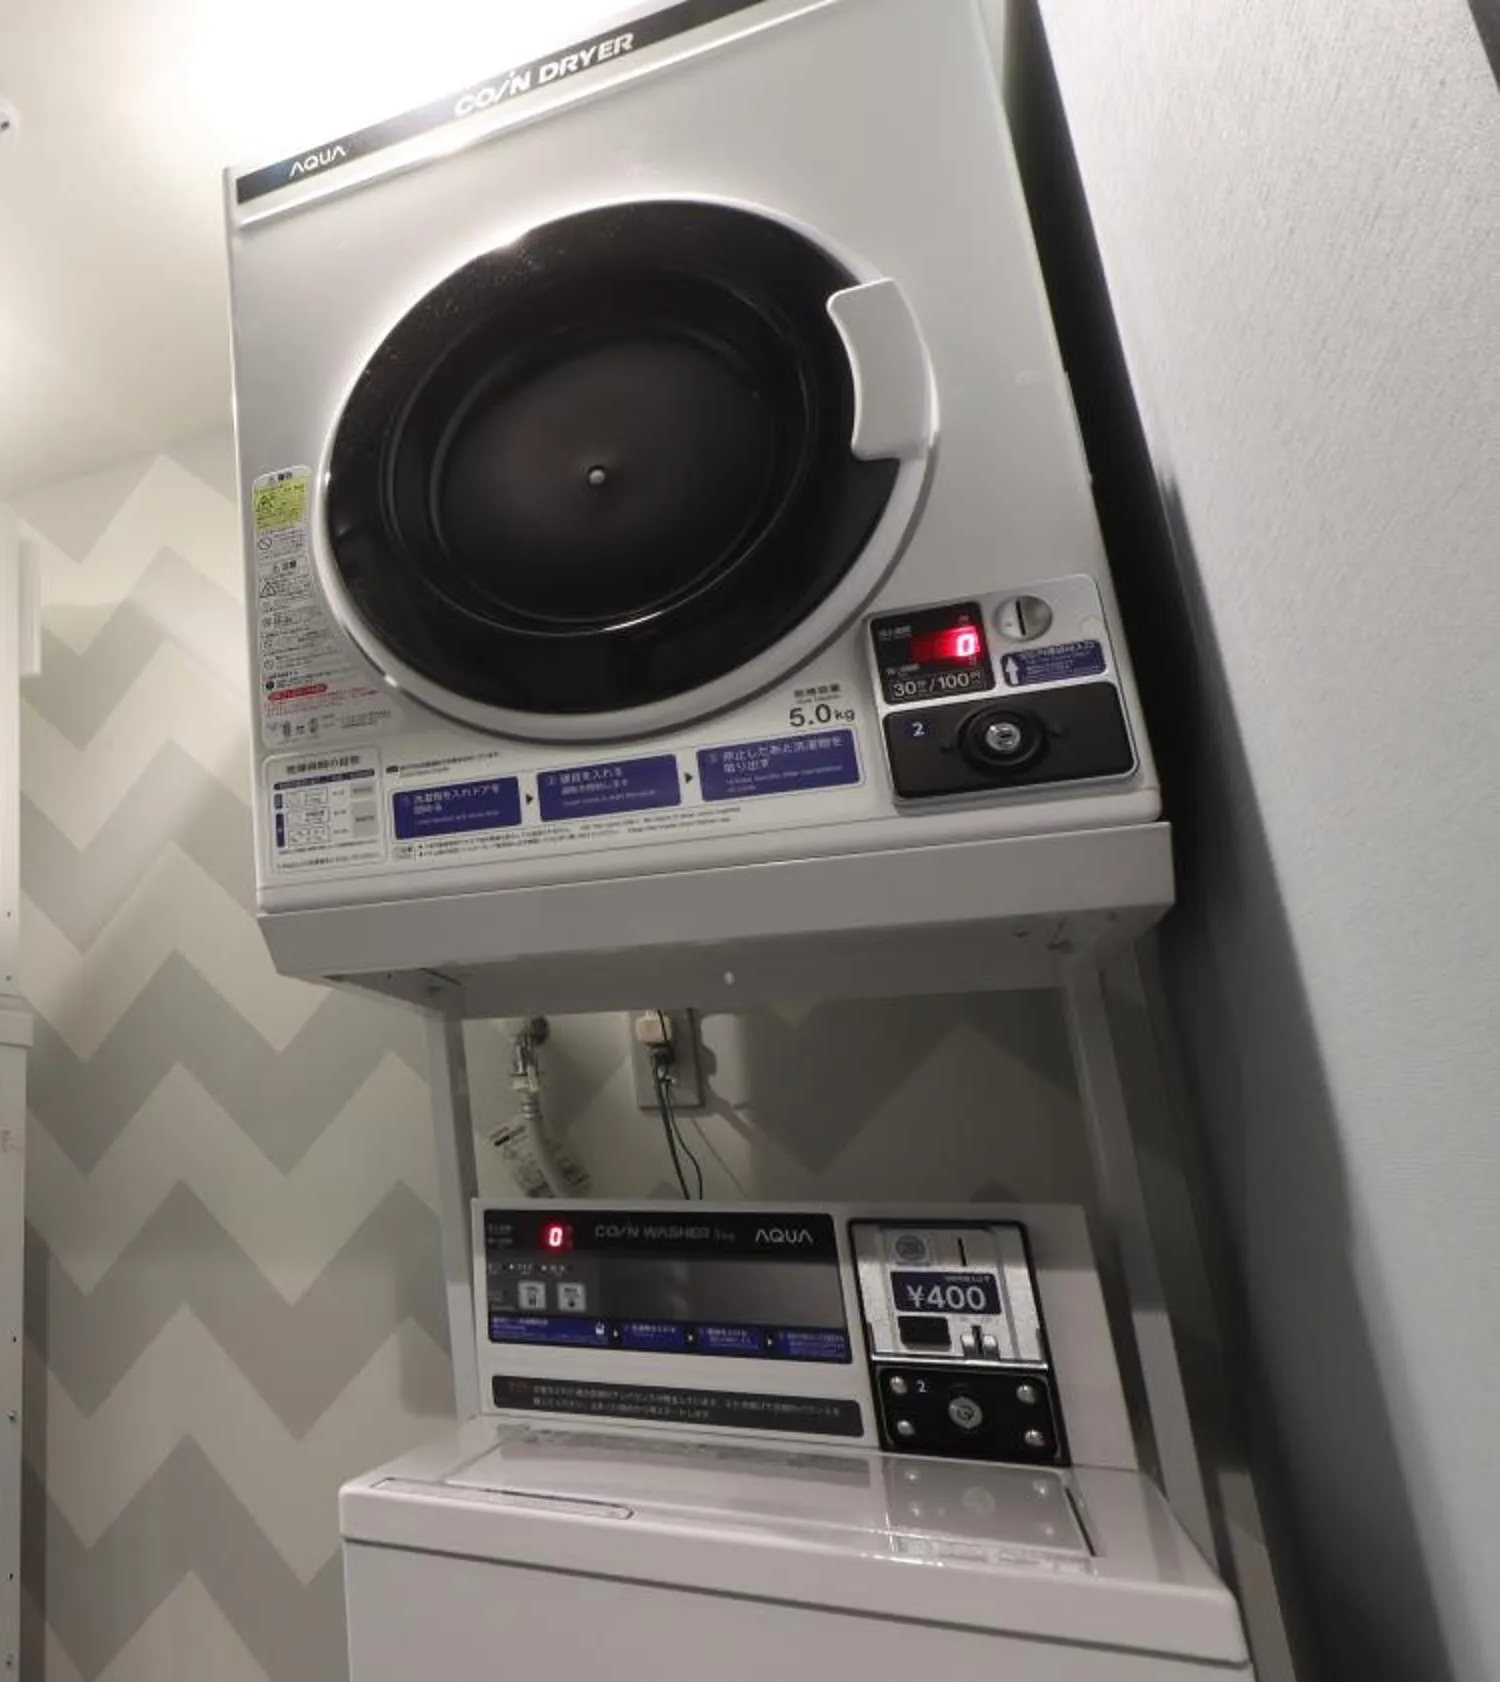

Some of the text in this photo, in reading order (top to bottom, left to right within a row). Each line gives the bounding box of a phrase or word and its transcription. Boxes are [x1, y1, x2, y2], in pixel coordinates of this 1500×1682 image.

[538, 31, 636, 83] DRYER
[289, 145, 347, 177] AQUA
[956, 632, 978, 657] 0
[911, 722, 925, 737] 2
[547, 1226, 564, 1248] 0
[755, 1227, 814, 1244] AQUA
[906, 1283, 986, 1311] ¥400
